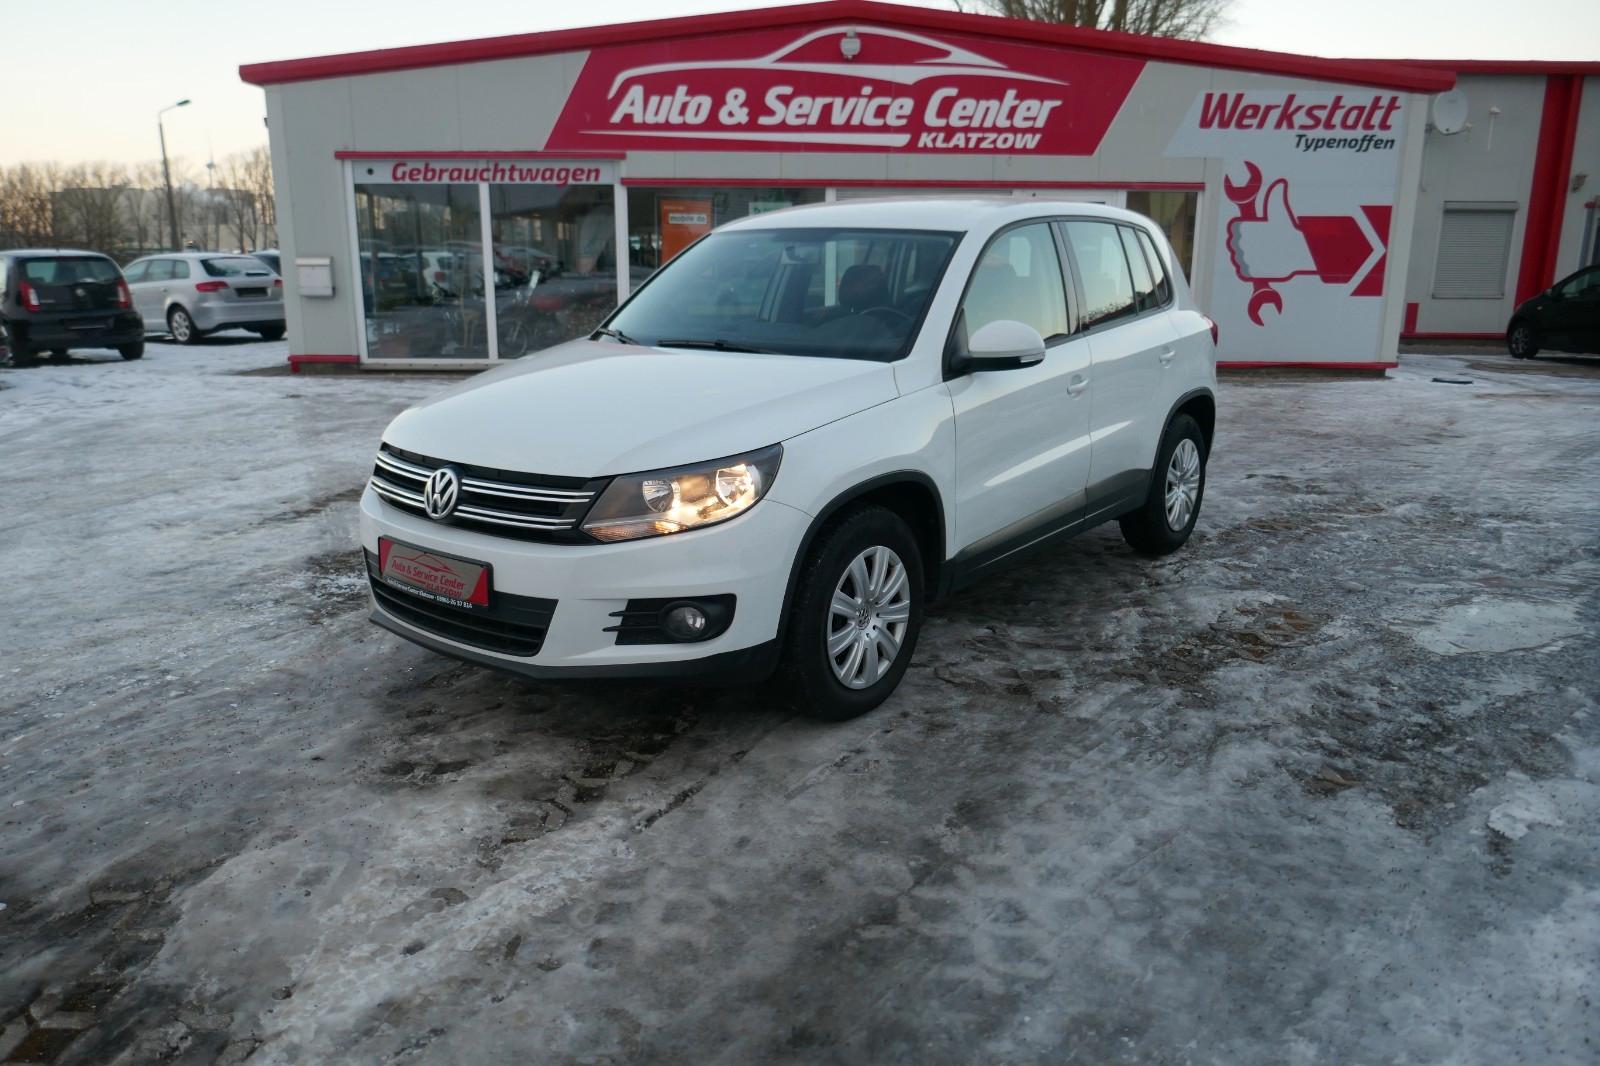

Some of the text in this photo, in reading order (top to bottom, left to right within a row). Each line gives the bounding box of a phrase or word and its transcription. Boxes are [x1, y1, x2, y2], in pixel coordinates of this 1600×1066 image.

[610, 85, 1062, 128] Auto & Service Center
[1199, 93, 1402, 130] Werkstatt
[918, 133, 1041, 149] KLATZOW
[1296, 134, 1395, 152] Typenoffen
[391, 162, 600, 187] Gebrauchtwagen
[391, 559, 405, 572] Auto
[413, 566, 438, 583] Service
[440, 575, 465, 590] Center
